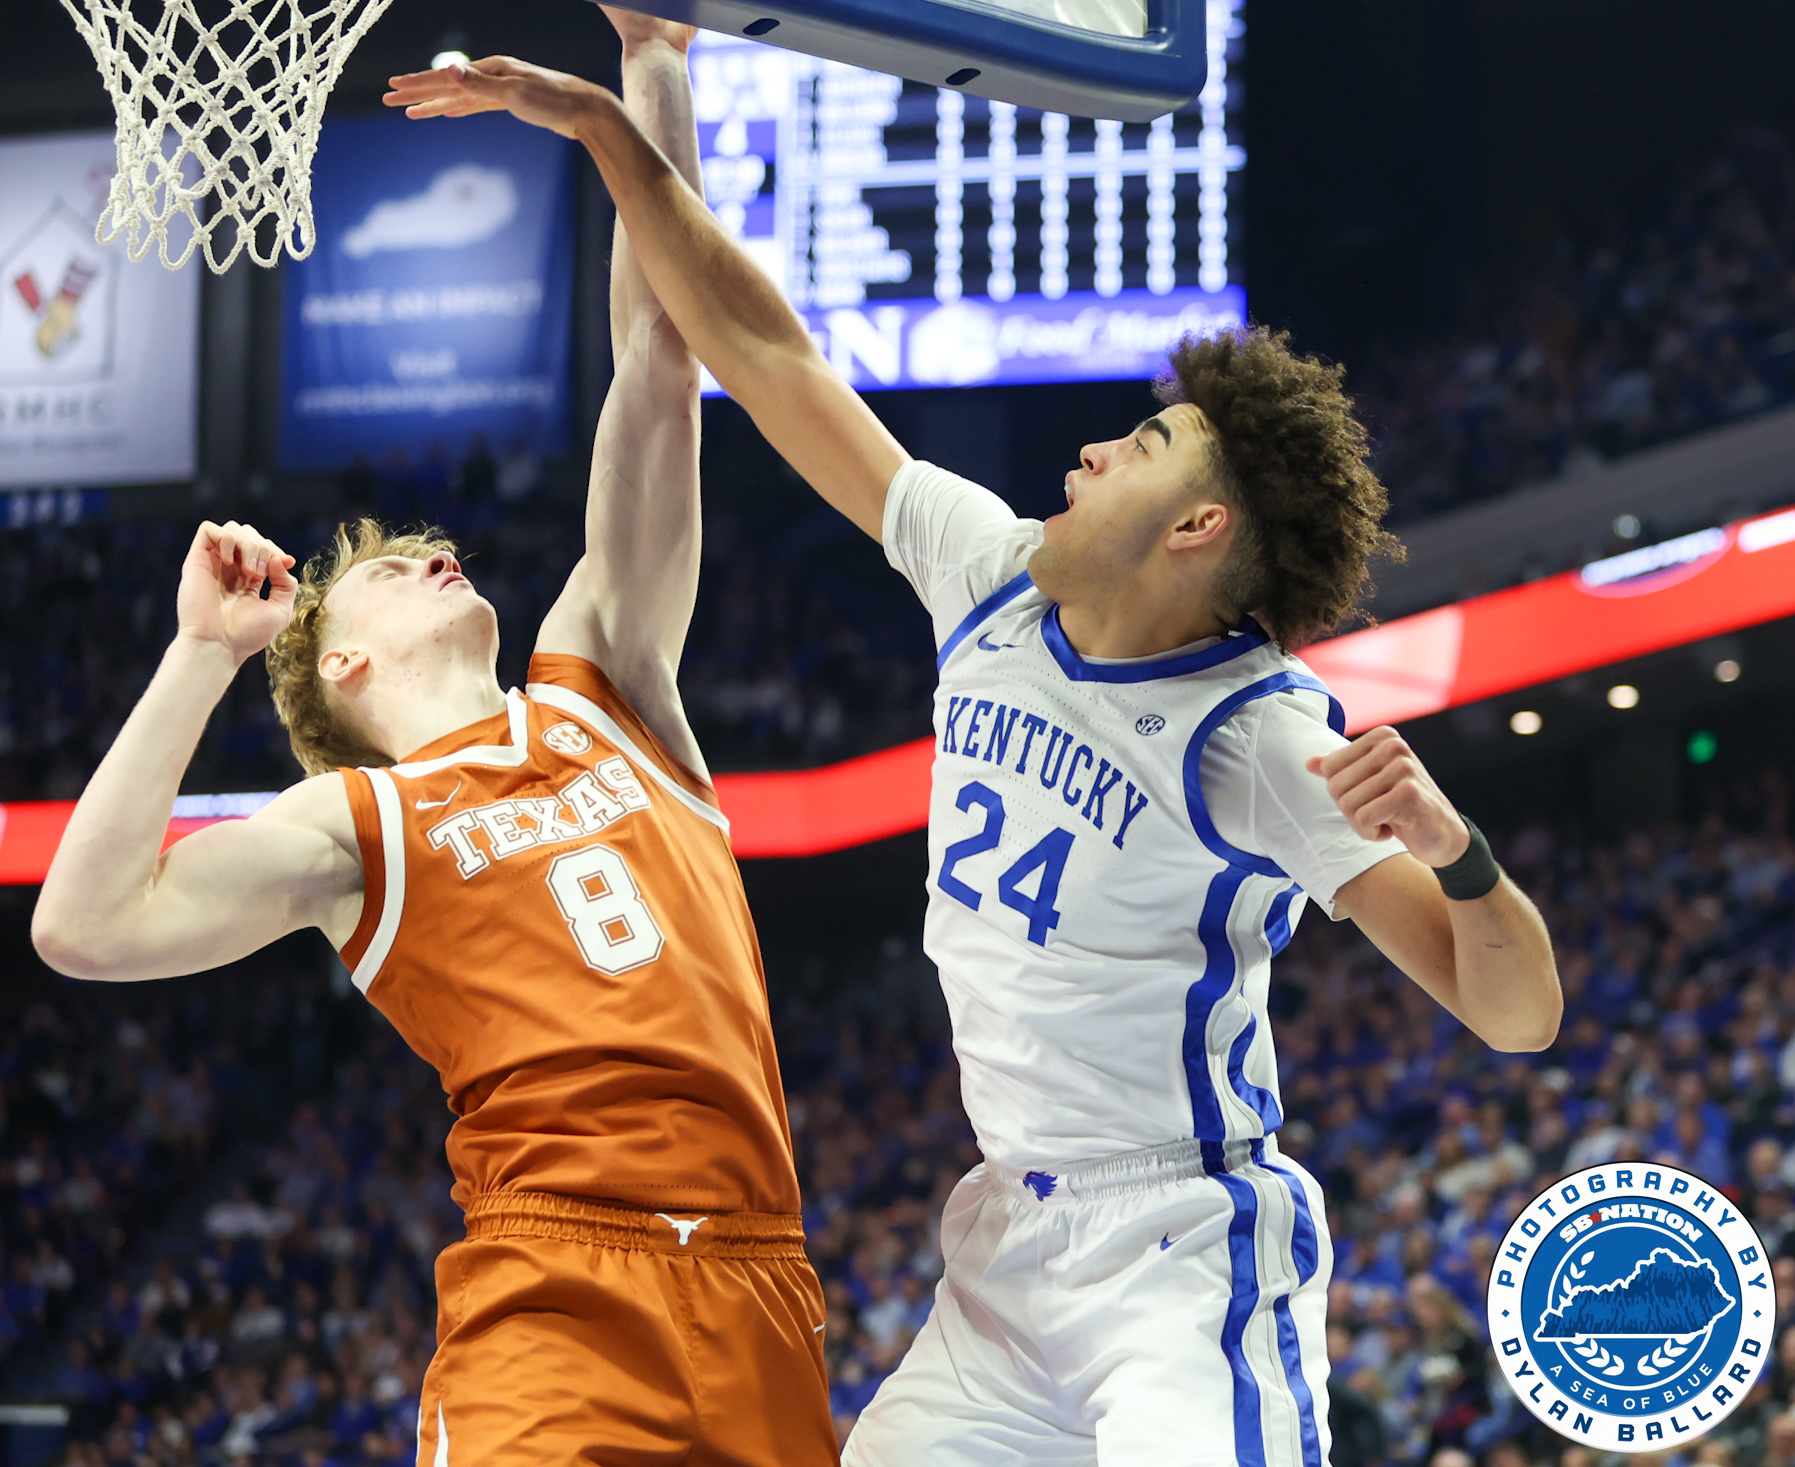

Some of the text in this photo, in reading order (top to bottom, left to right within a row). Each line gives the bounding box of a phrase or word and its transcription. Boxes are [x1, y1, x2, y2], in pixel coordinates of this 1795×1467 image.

[303, 290, 384, 325] MAKE
[390, 288, 432, 320] AN
[0, 390, 110, 426] MHC
[545, 724, 590, 754] SEC
[1136, 715, 1165, 735] SEC
[943, 696, 1149, 850] KENTUCKY
[426, 754, 651, 880] TEXAS
[937, 780, 1076, 948] 24
[545, 843, 666, 977] 8
